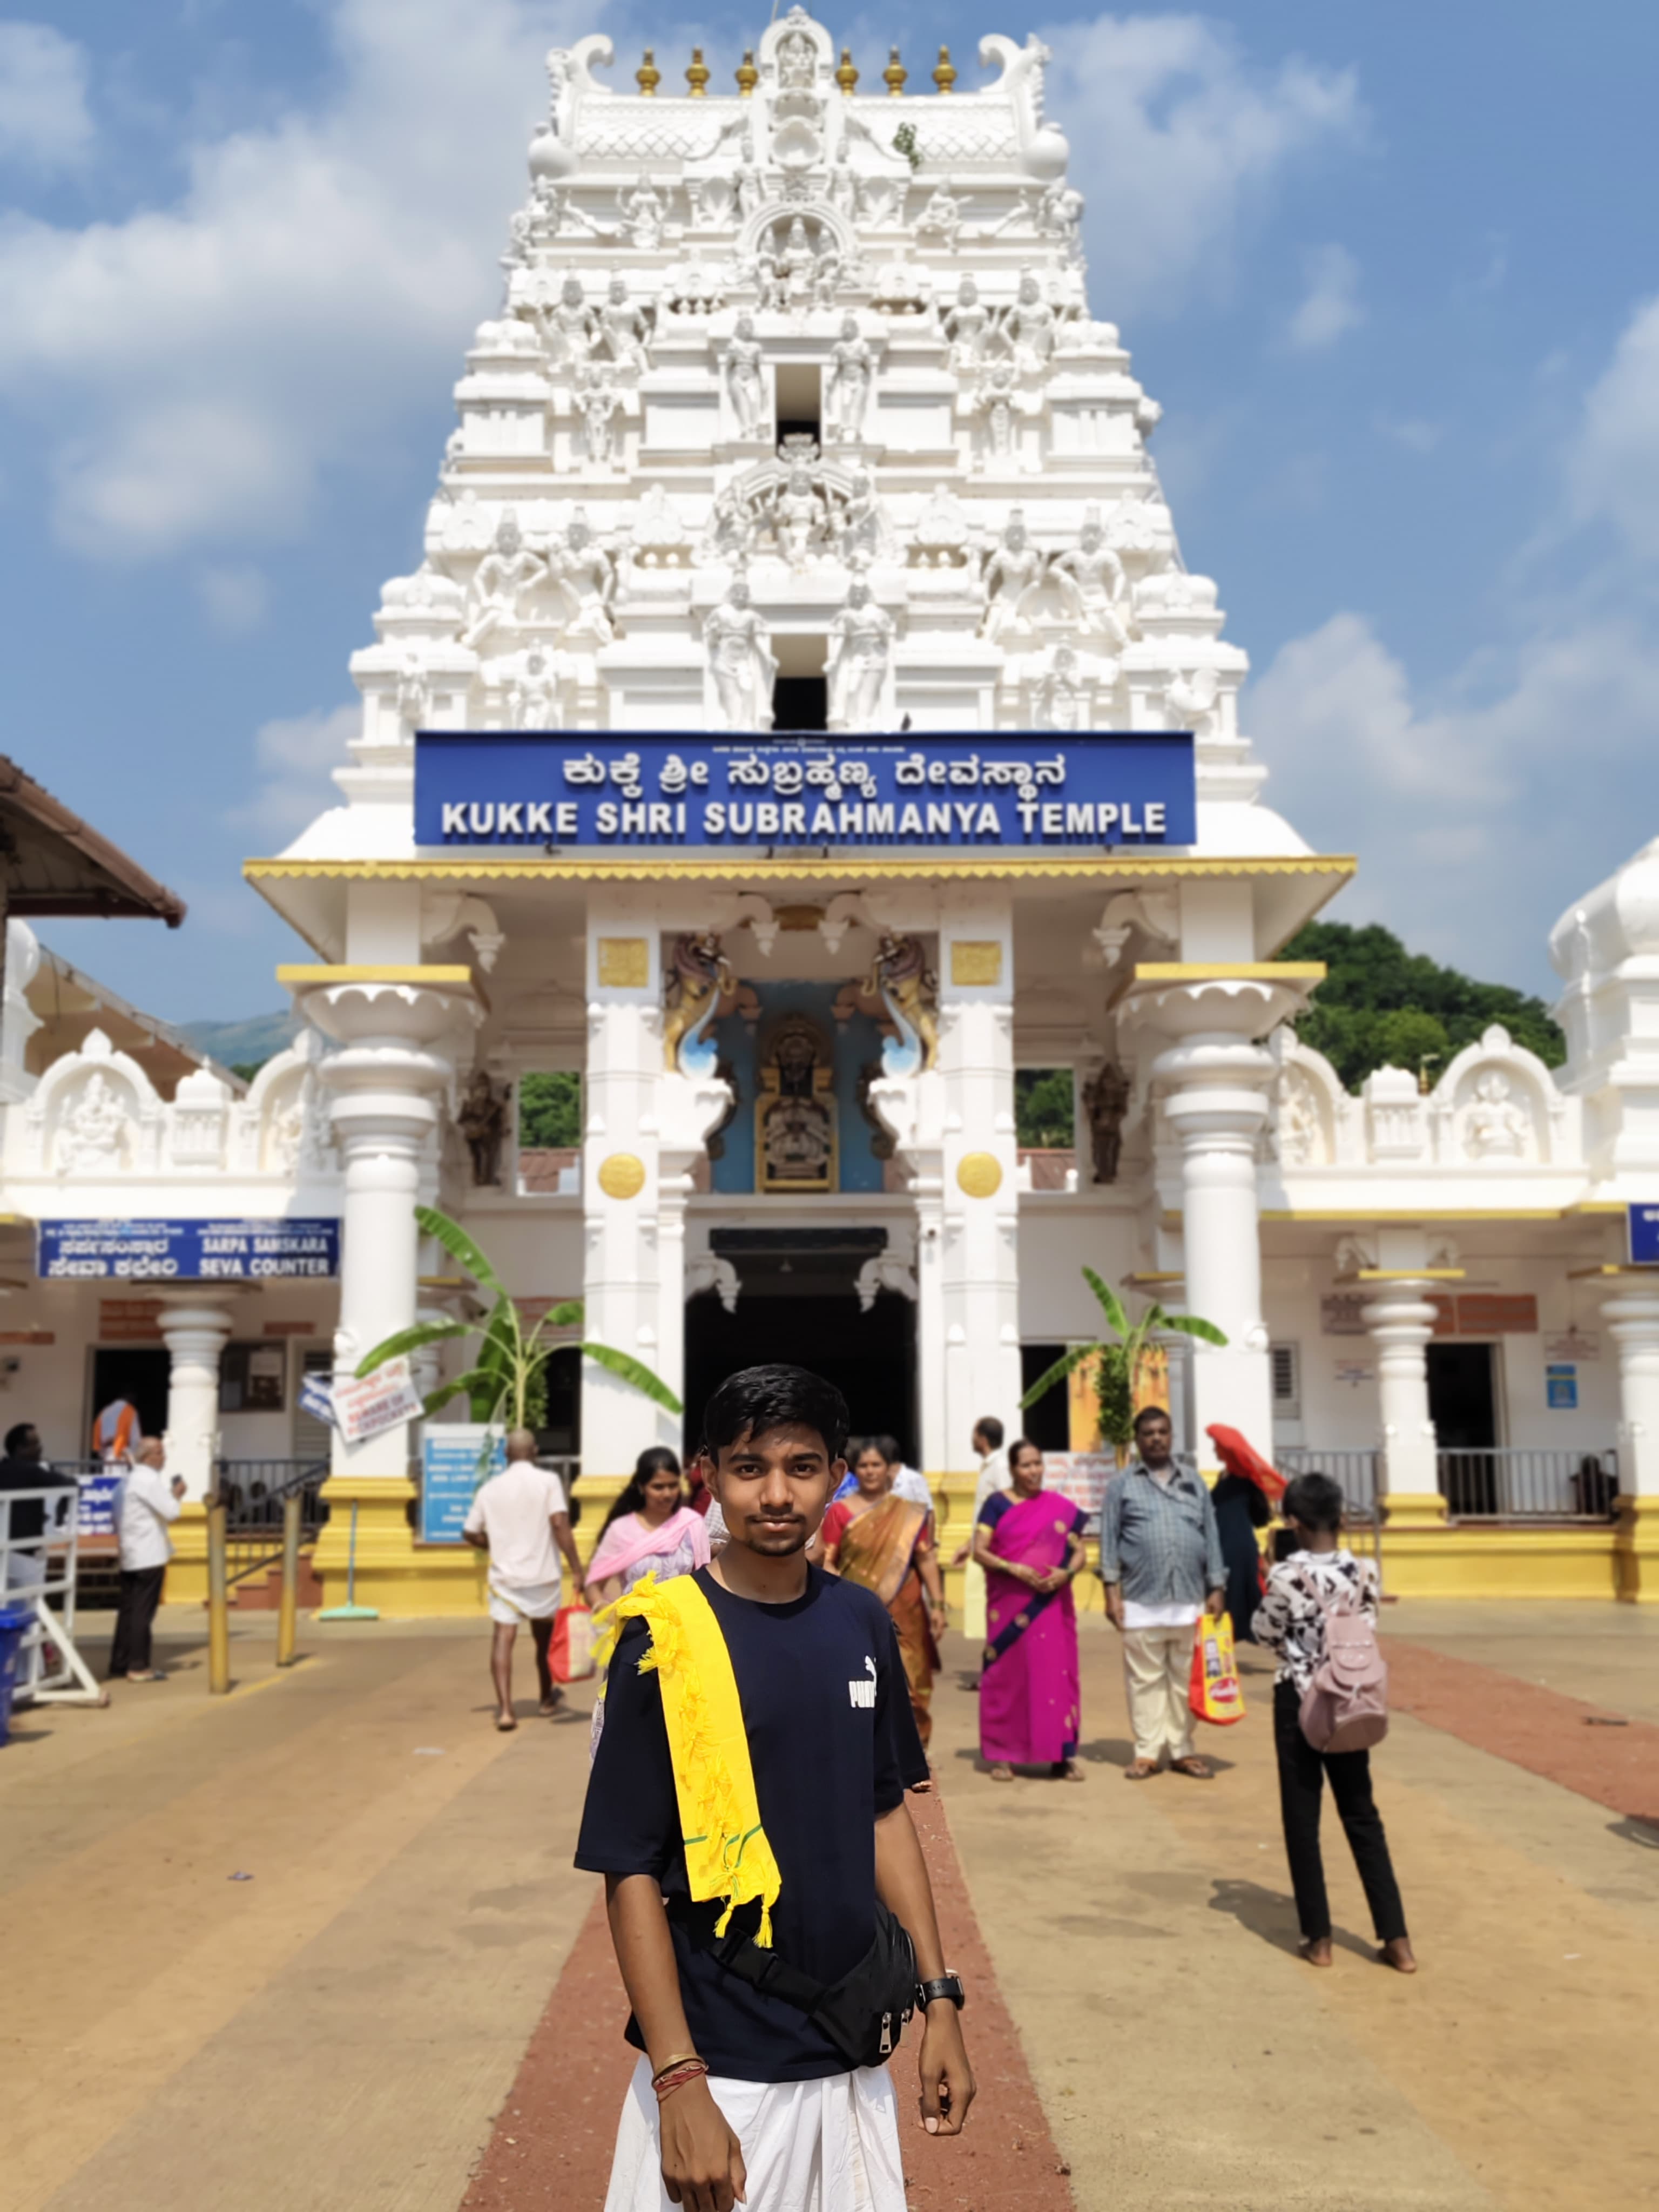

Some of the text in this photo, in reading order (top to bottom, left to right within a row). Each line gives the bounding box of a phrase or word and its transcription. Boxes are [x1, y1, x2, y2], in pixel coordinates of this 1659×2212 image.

[563, 753, 1065, 801] ಕುಕ್ಕೆ ಶ್ರೀ ಸುಬ್ರಹ್ಮಣ್ಯ ದೇವಸ್ಥಾನ
[442, 803, 1166, 834] KUKKE SHRI SUBRAHMANYA TEMPLE
[202, 1237, 248, 1253] SARPA
[200, 1258, 329, 1276] SEVA COUNTER
[848, 1680, 876, 1708] PUM
